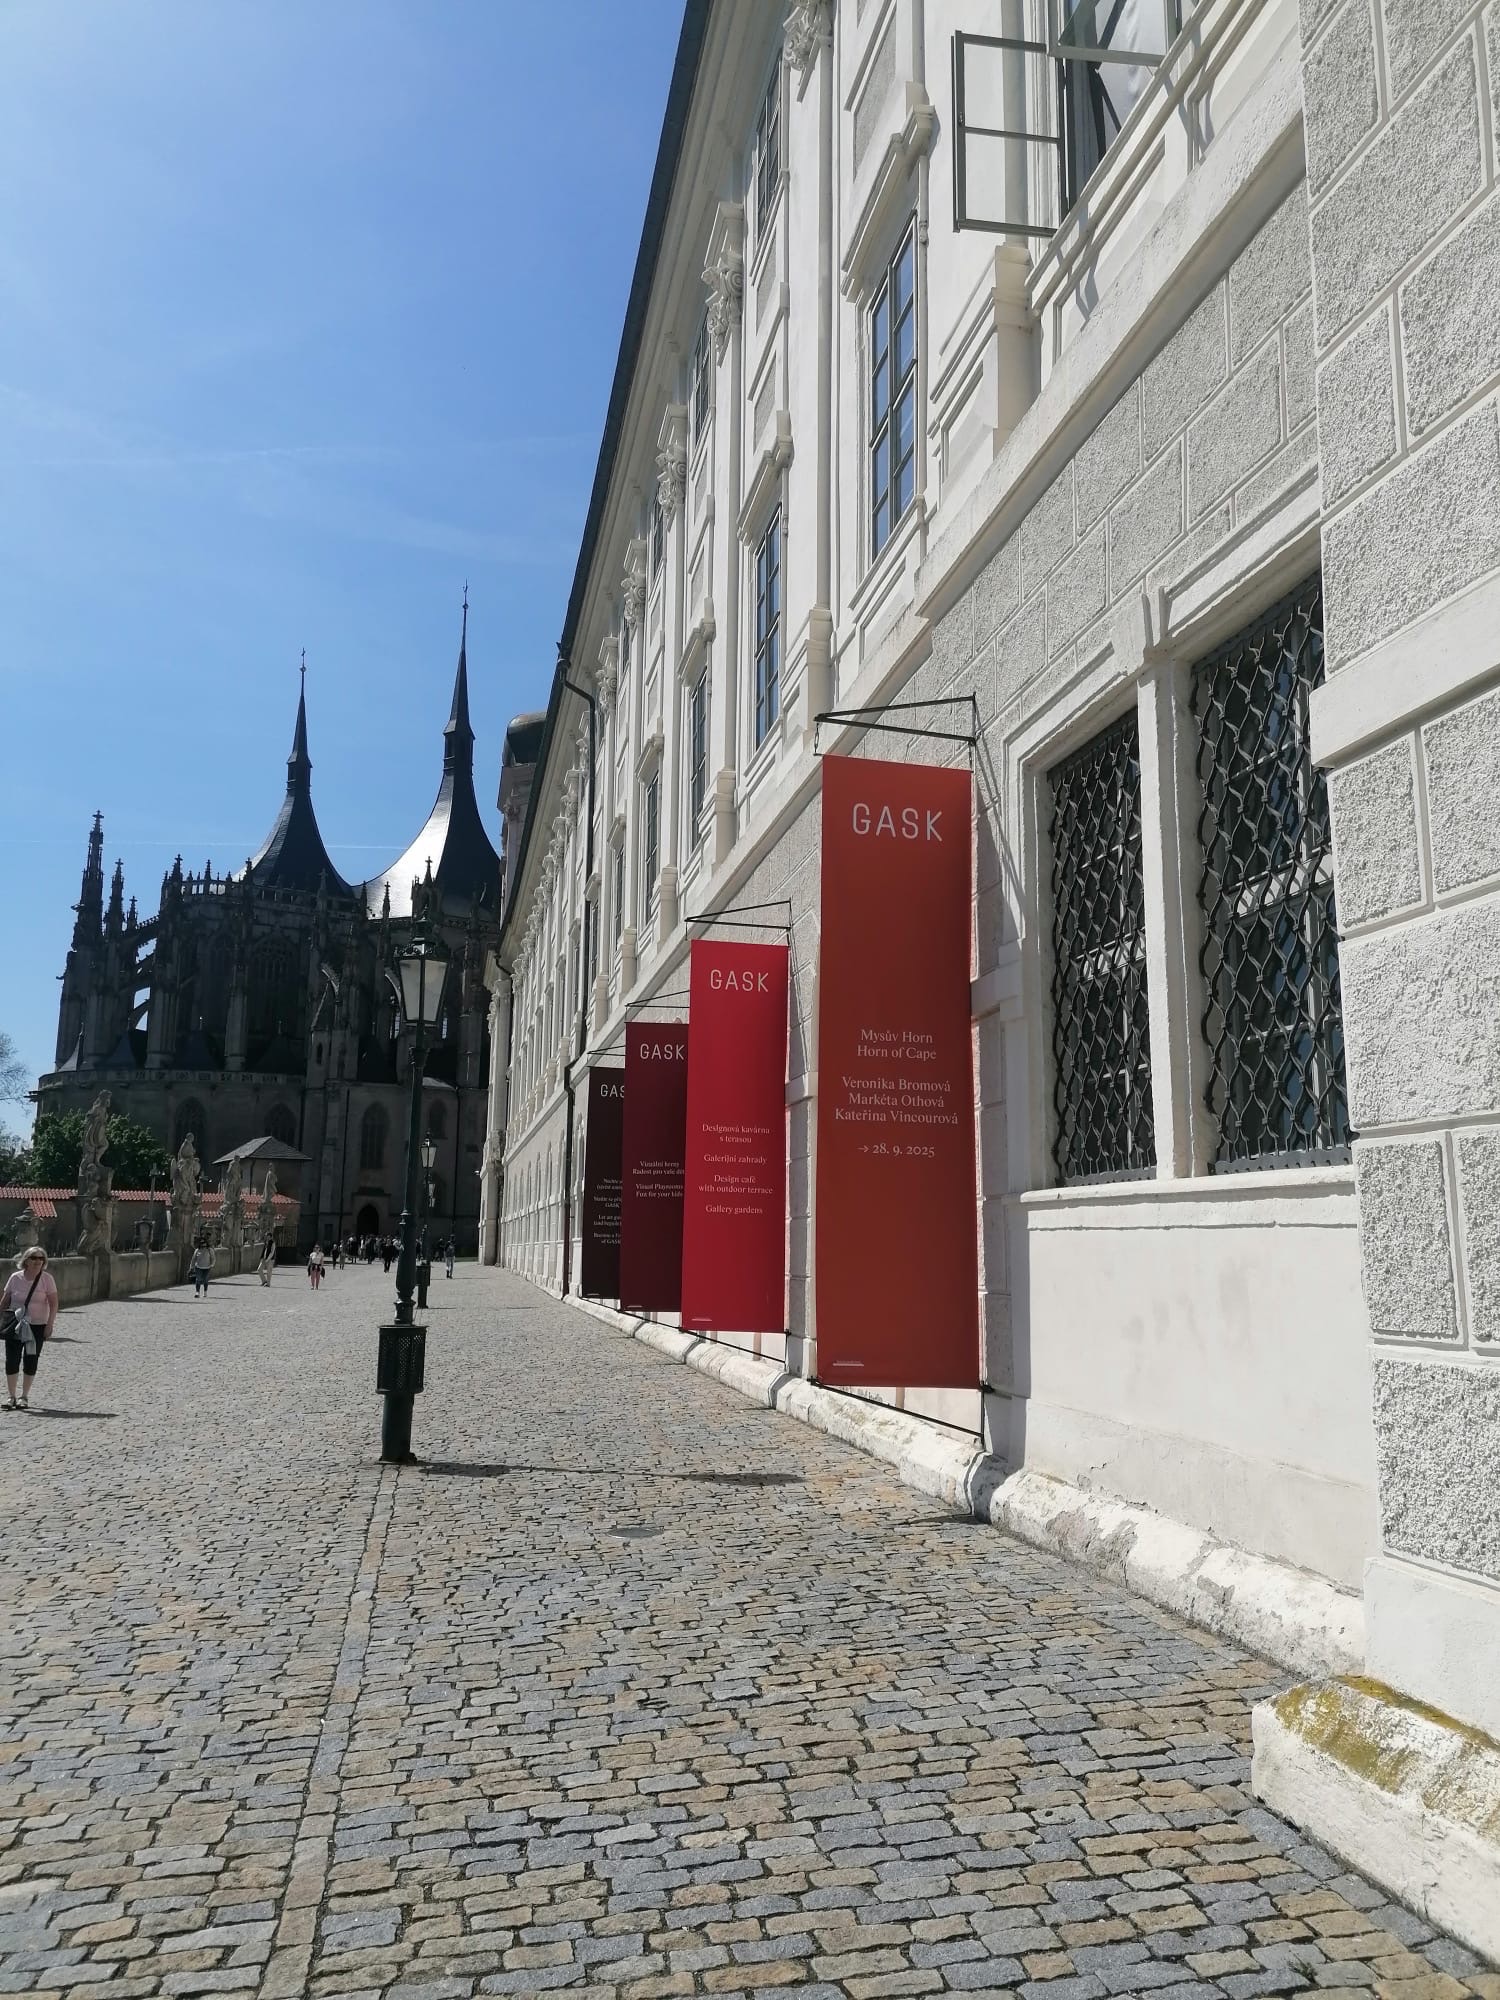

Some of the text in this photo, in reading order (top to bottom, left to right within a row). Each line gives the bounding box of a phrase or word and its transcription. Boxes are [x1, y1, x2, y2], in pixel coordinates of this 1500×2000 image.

[852, 802, 942, 842] GASK
[710, 969, 769, 993] GASK
[861, 1029, 933, 1044] Mysův Horn
[640, 1043, 685, 1060] GASK
[857, 1045, 937, 1061] Horn of Cape
[600, 1084, 625, 1098] GAS
[842, 1076, 951, 1092] Veronika Bromová
[848, 1092, 945, 1108] Markéta Othová
[835, 1108, 959, 1125] Kateřina Vincourová
[872, 1143, 935, 1158] 28. 9. 2025
[703, 1153, 767, 1166] Galerijní zahrady
[714, 1174, 740, 1184] Design
[698, 1184, 773, 1194] with outdoor terrace
[705, 1204, 763, 1215] Gallery gardens
